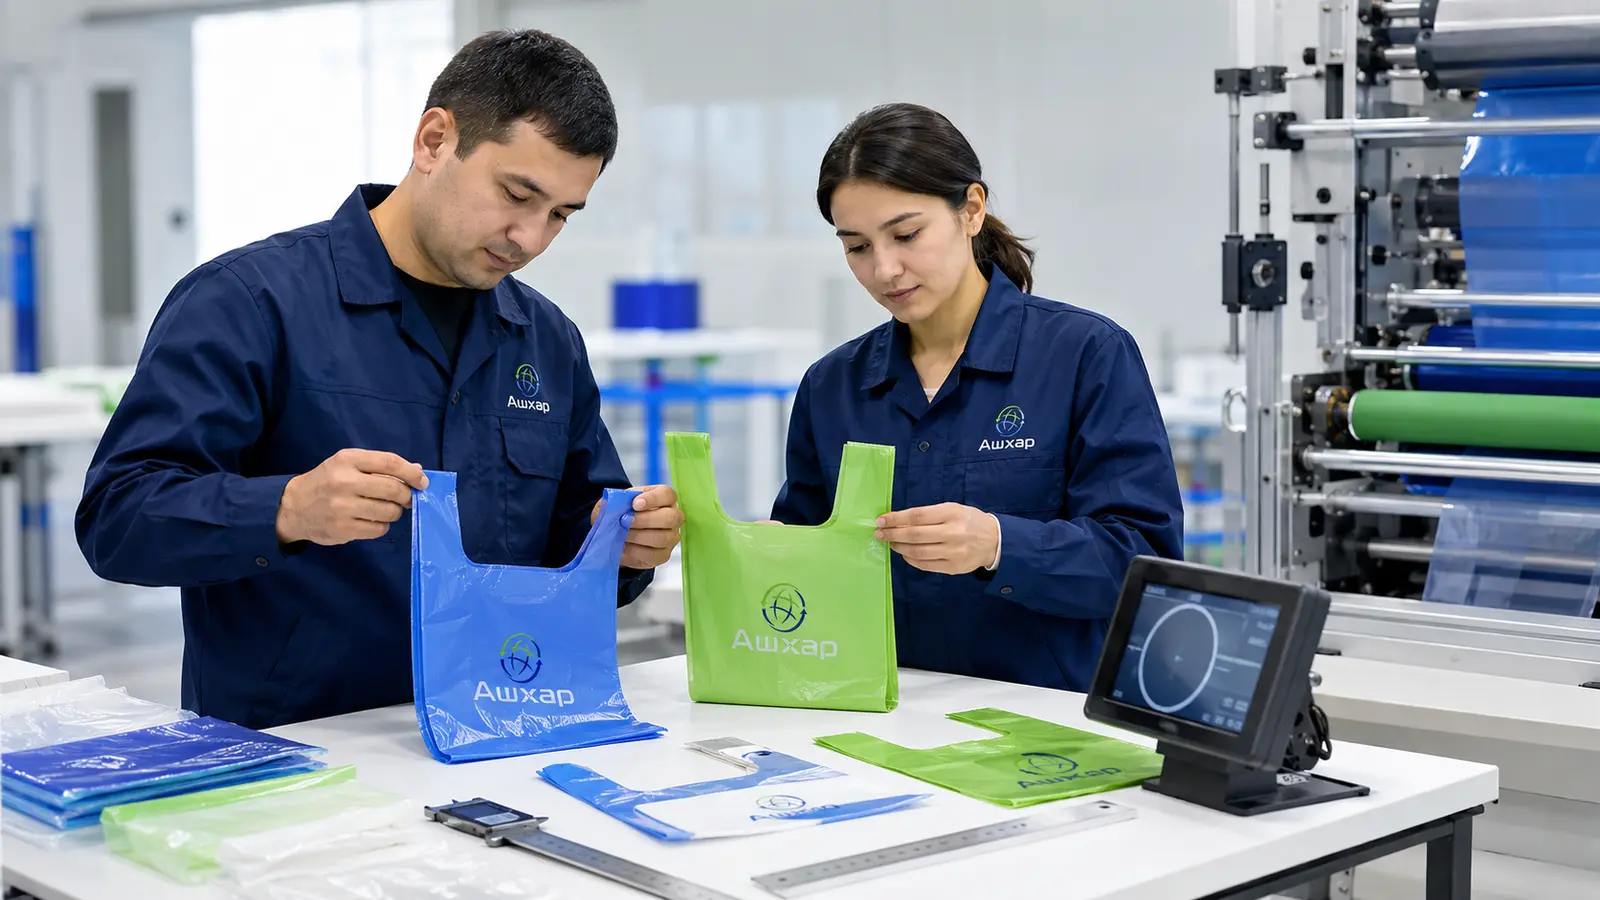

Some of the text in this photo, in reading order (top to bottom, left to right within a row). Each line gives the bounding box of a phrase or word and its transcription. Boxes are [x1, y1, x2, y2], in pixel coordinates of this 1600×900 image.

[507, 395, 550, 414] Ашхар
[978, 438, 1035, 451] Ашхар
[731, 629, 838, 660] Ашхар
[474, 681, 575, 707] Ашхар
